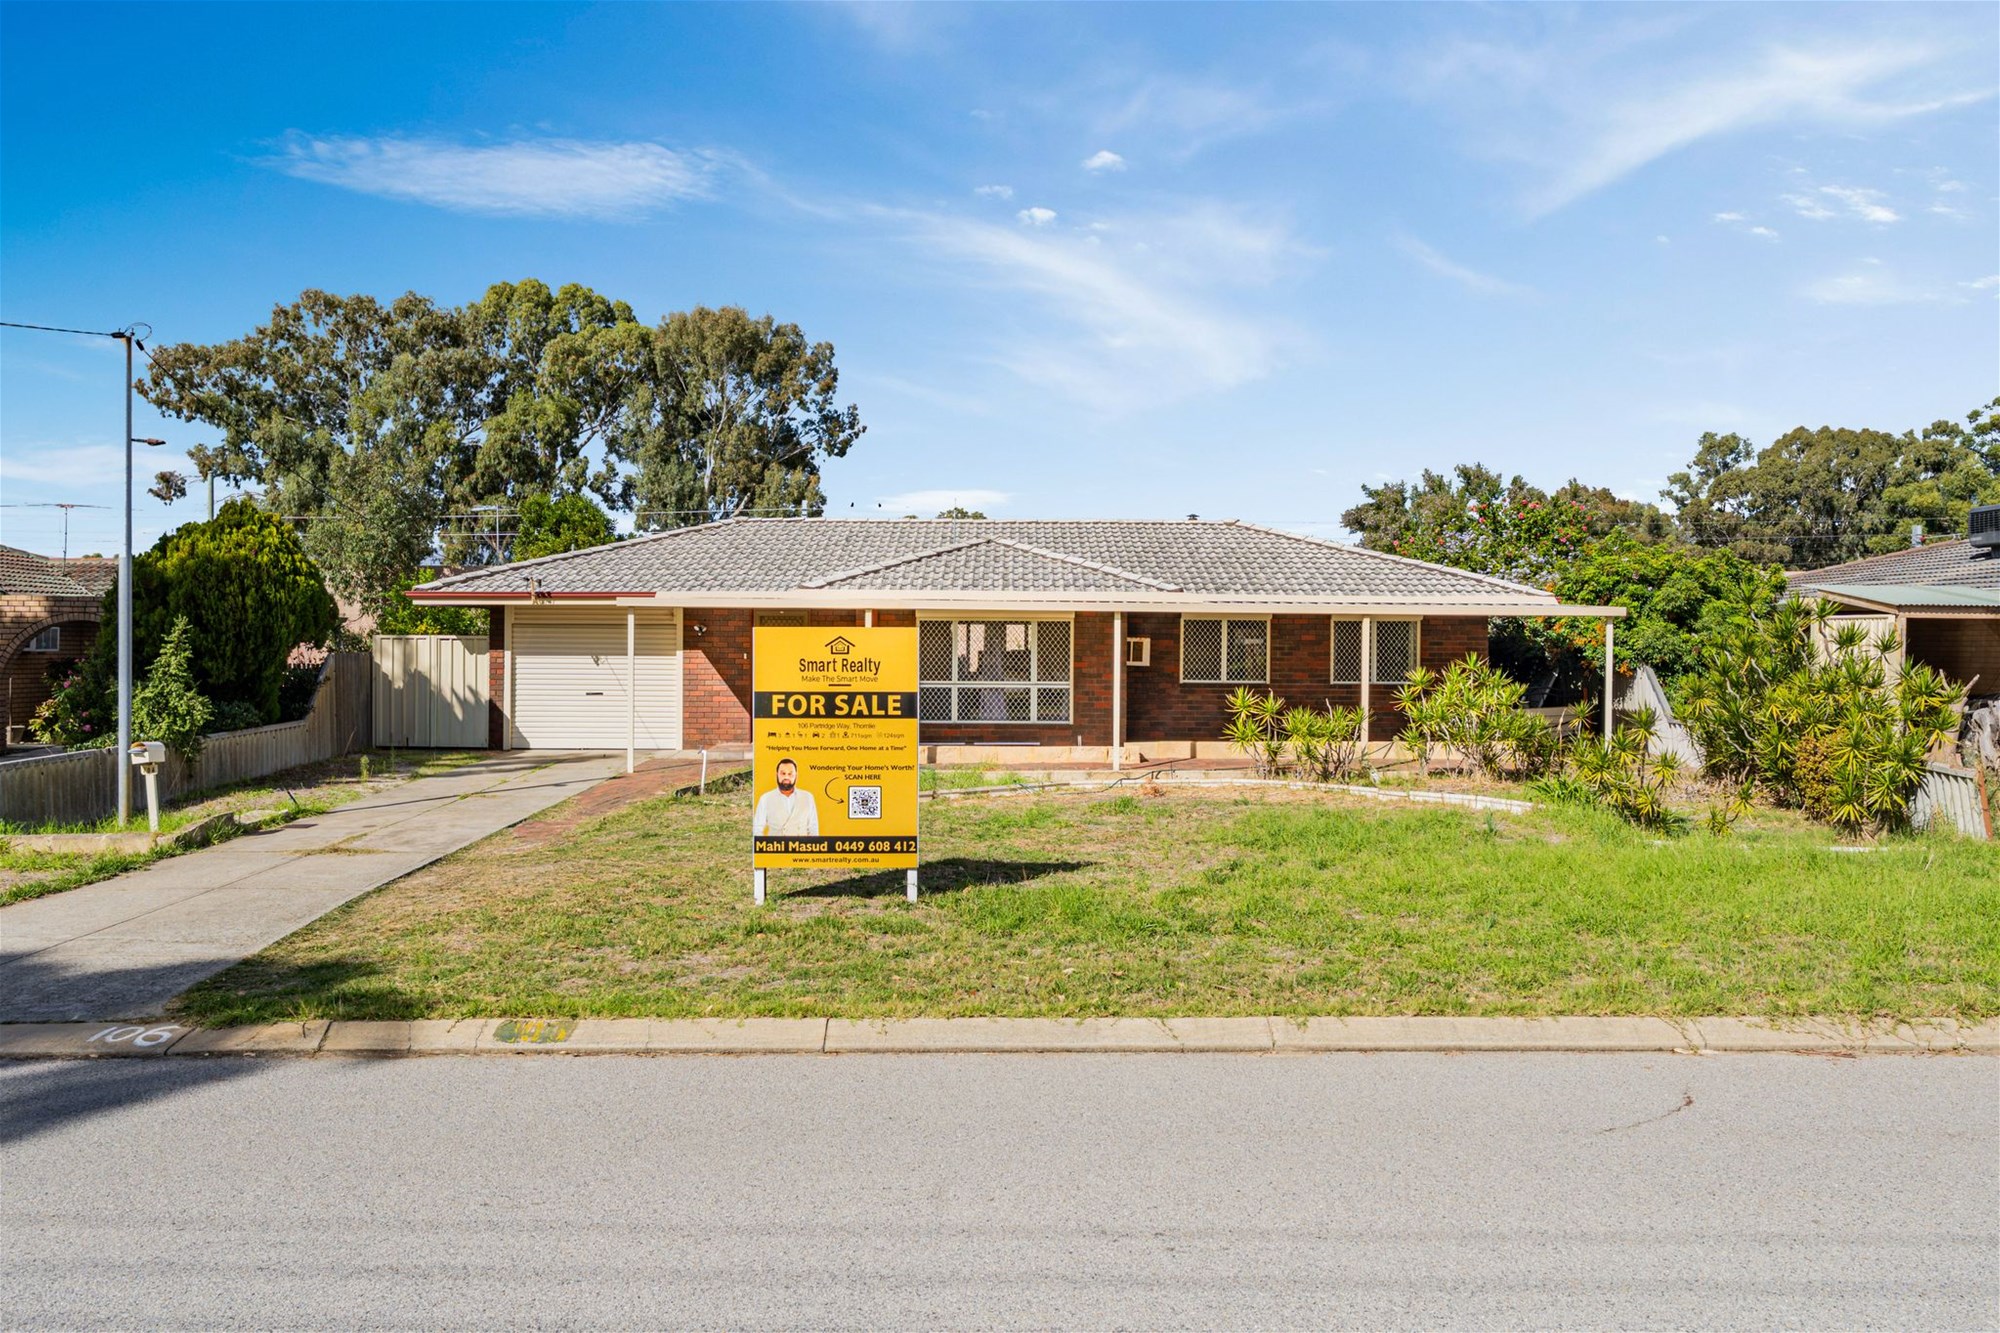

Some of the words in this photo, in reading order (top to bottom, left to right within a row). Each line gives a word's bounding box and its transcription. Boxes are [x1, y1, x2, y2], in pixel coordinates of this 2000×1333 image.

[799, 658, 837, 672] Smart
[841, 657, 881, 675] Realty
[772, 694, 826, 715] FOR
[835, 694, 902, 715] SALE
[810, 722, 835, 730] Partridge
[809, 764, 846, 772] Wondering
[756, 840, 785, 852] Mahi
[788, 840, 828, 852] Masud
[835, 840, 865, 852] 0449
[868, 840, 890, 852] 608
[894, 840, 916, 852] 412
[792, 856, 880, 864] www.smartrealty.com.au
[85, 1025, 180, 1047] 106
